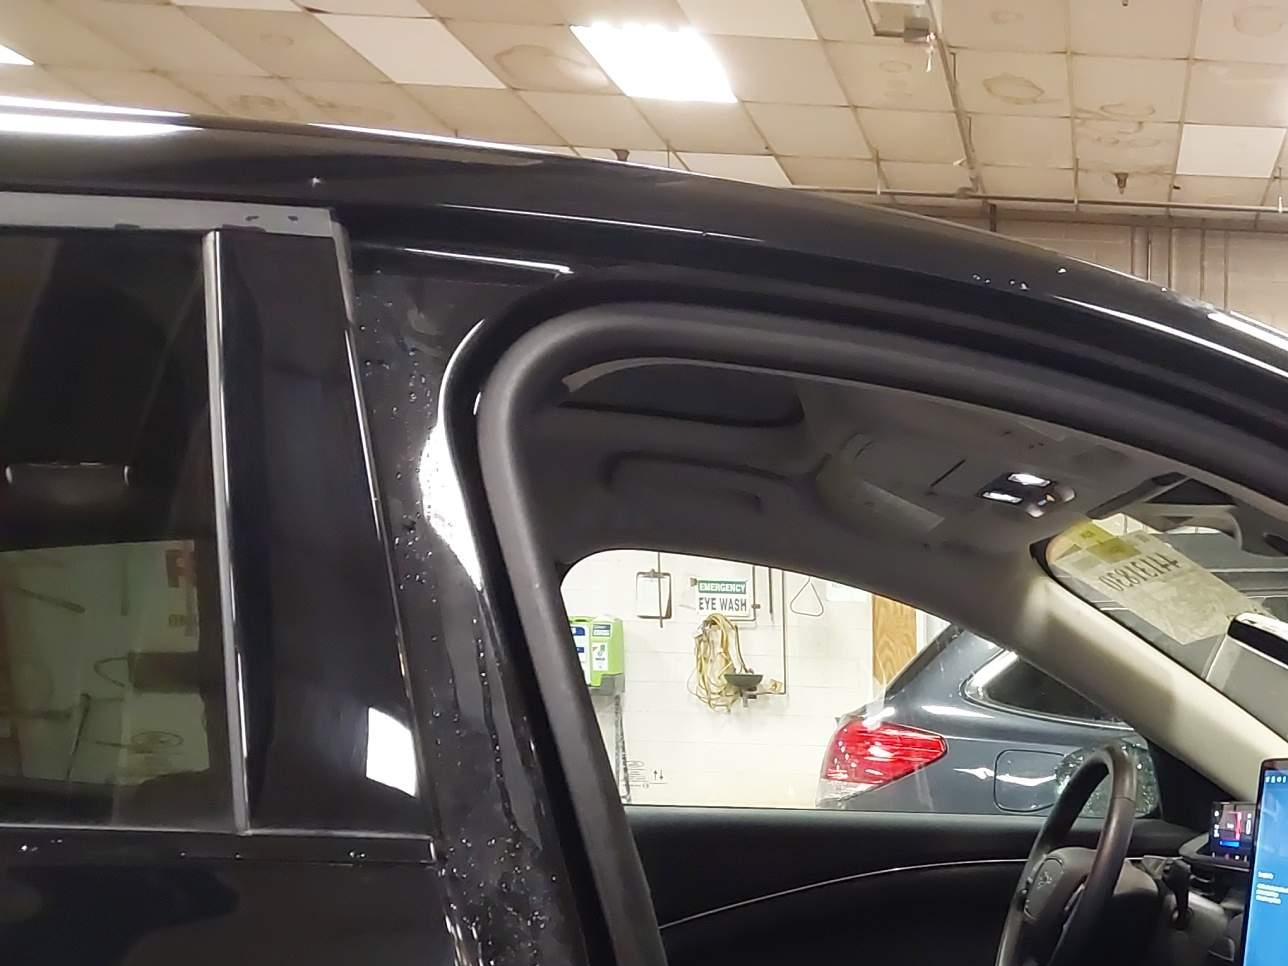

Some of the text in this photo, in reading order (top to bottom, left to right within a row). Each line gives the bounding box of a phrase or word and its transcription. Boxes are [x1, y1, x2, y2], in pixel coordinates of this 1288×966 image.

[699, 582, 747, 593] EMERGENCY
[699, 597, 747, 612] EYE WASH
